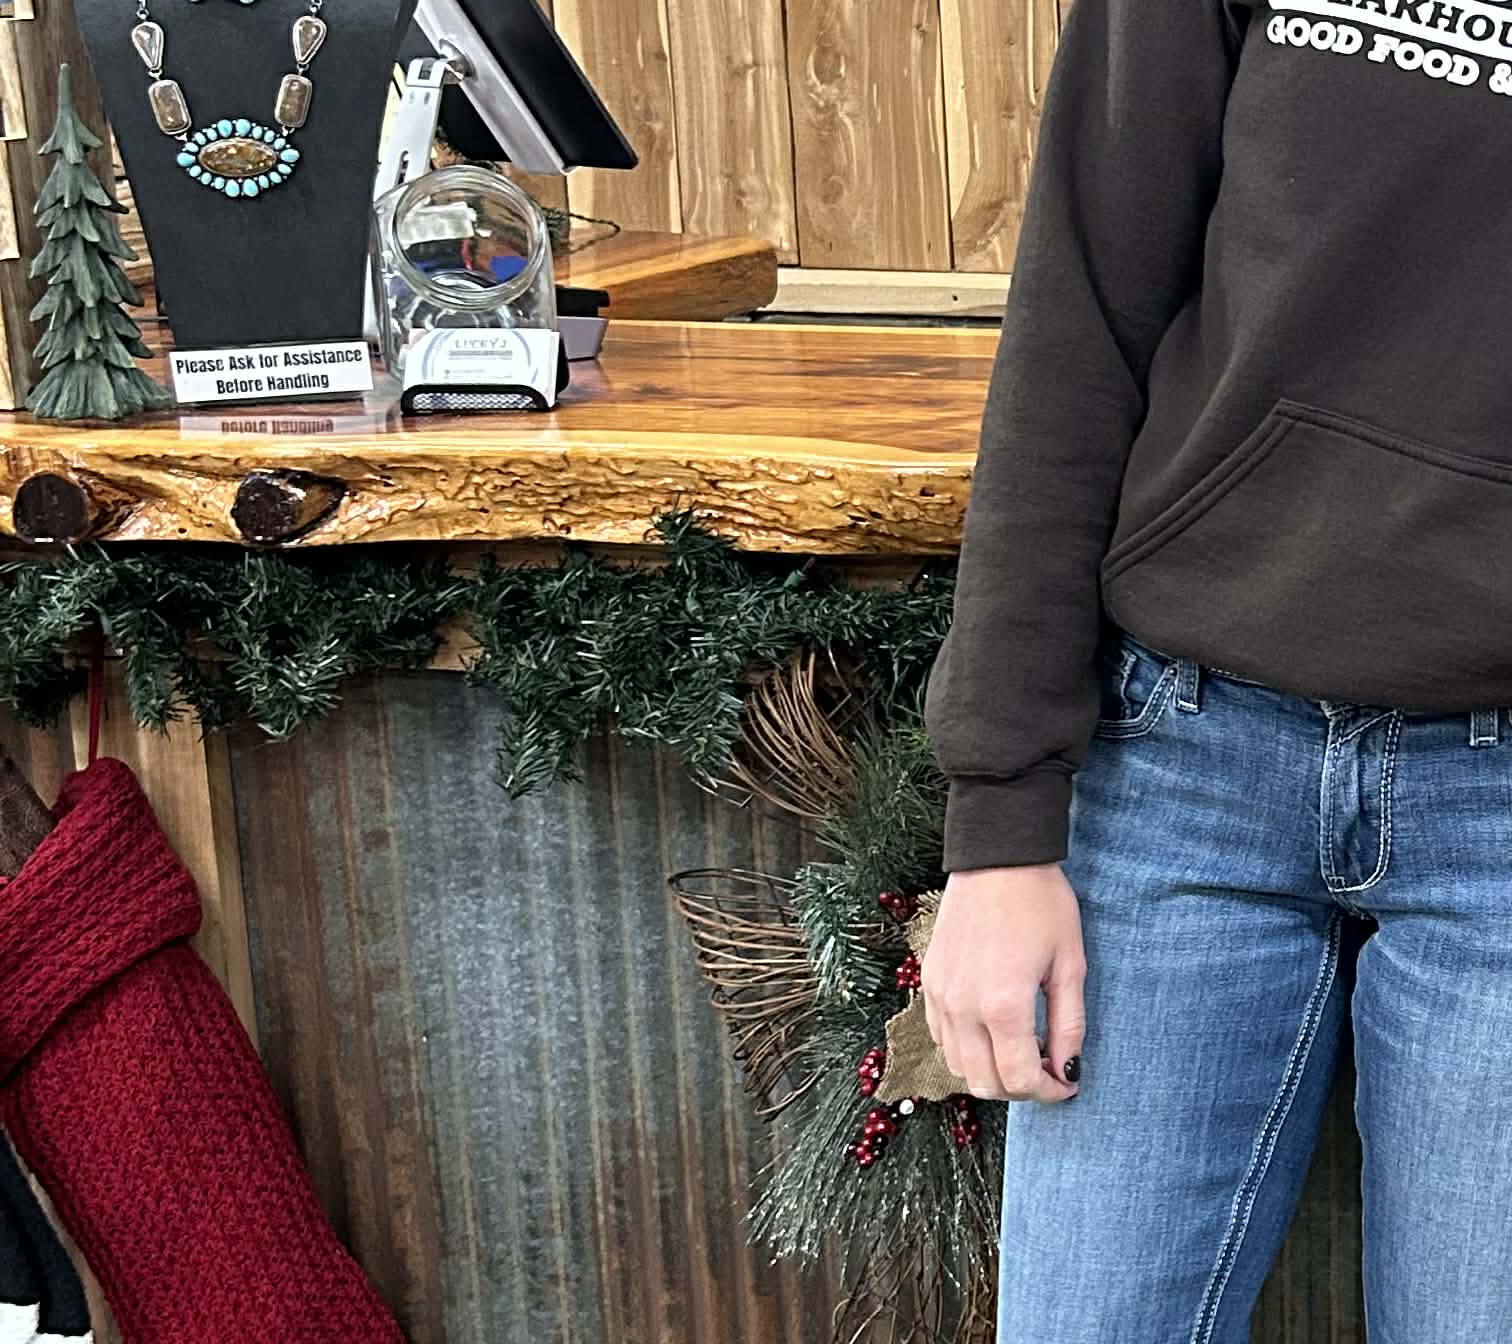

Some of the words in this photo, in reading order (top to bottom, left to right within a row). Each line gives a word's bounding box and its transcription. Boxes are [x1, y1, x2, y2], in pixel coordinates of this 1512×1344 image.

[1266, 15, 1364, 56] GOOD
[1367, 32, 1481, 87] FOOD
[176, 359, 225, 374] Please
[229, 356, 255, 371] Ask
[259, 353, 279, 369] for
[283, 348, 363, 367] Assistance
[216, 377, 264, 395] Before
[267, 374, 330, 391] Handling
